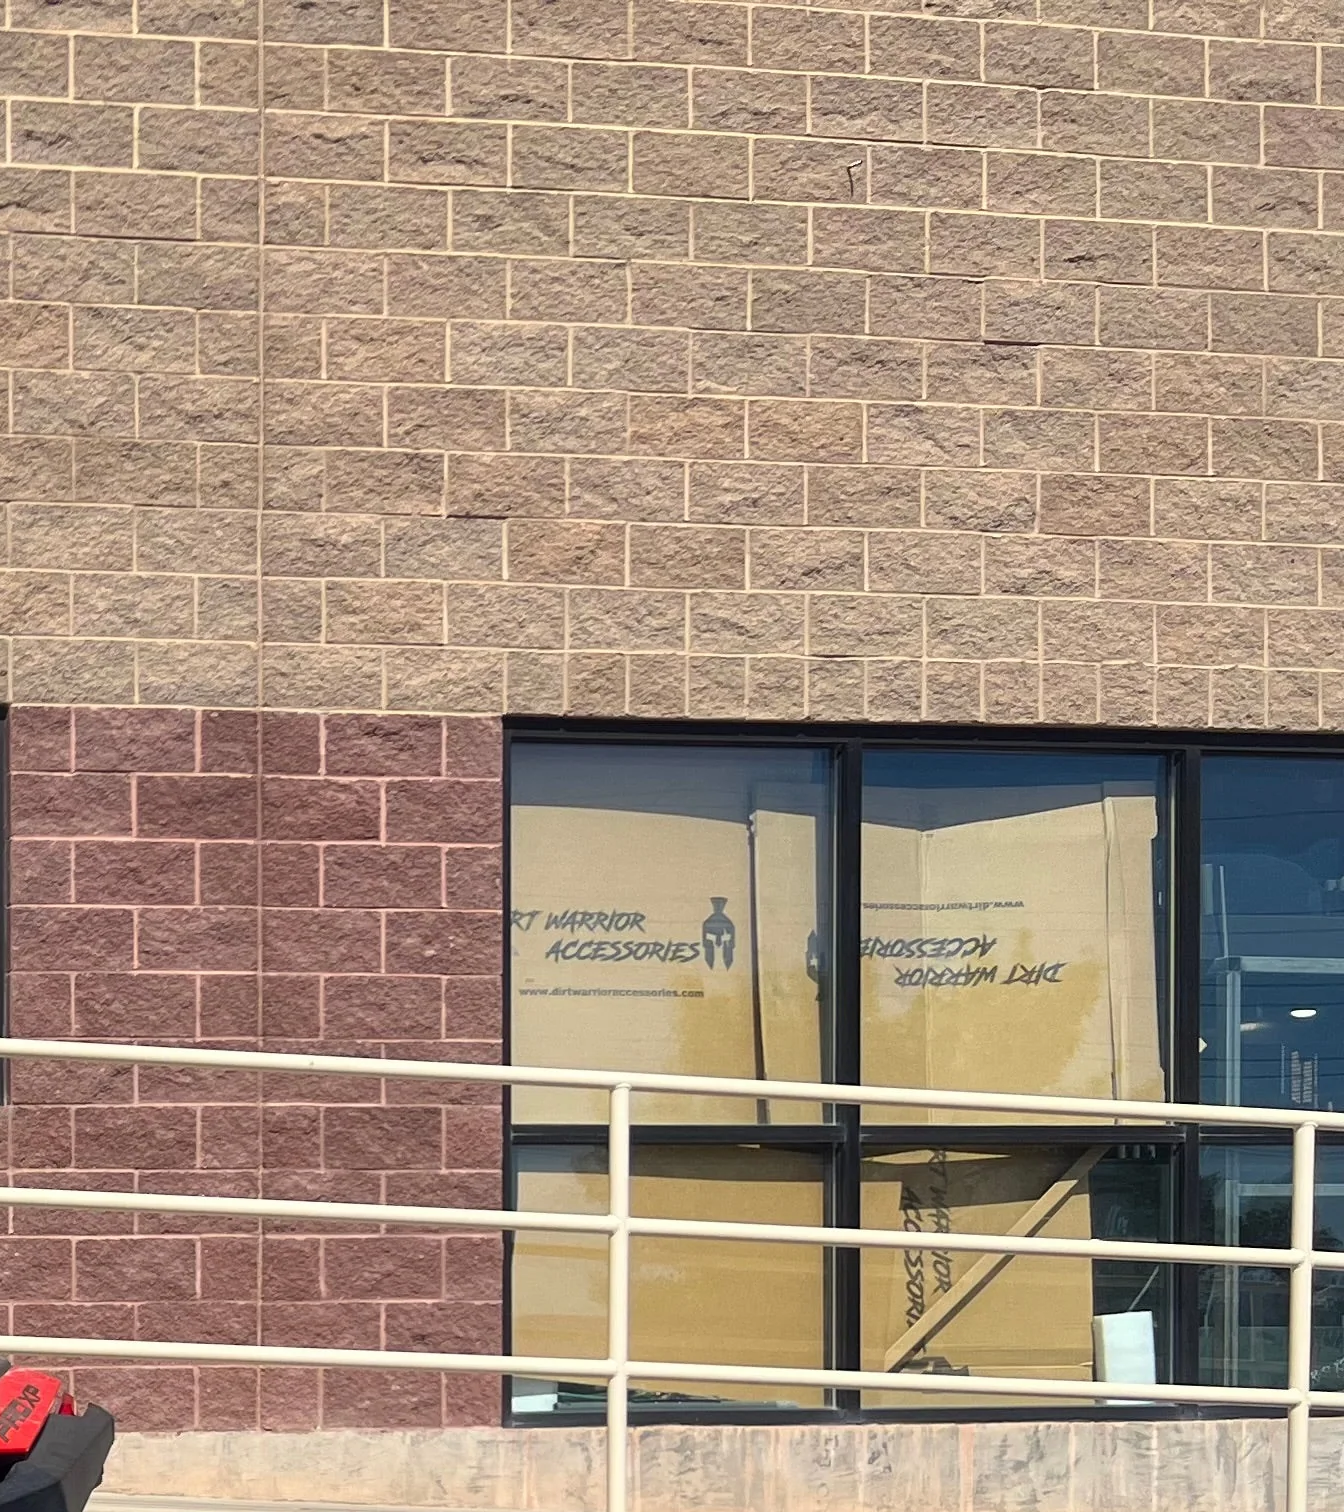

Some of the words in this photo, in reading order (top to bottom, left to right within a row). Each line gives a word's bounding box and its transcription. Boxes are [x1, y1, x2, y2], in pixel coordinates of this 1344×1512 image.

[511, 909, 543, 932] RT
[544, 908, 647, 934] WARRIOR
[545, 939, 700, 964] ACCESSORIES
[861, 934, 999, 960] ACCESSORIE
[894, 962, 999, 989] WARRIOR
[1001, 960, 1068, 987] DIRT
[928, 1185, 953, 1296] WARIOR
